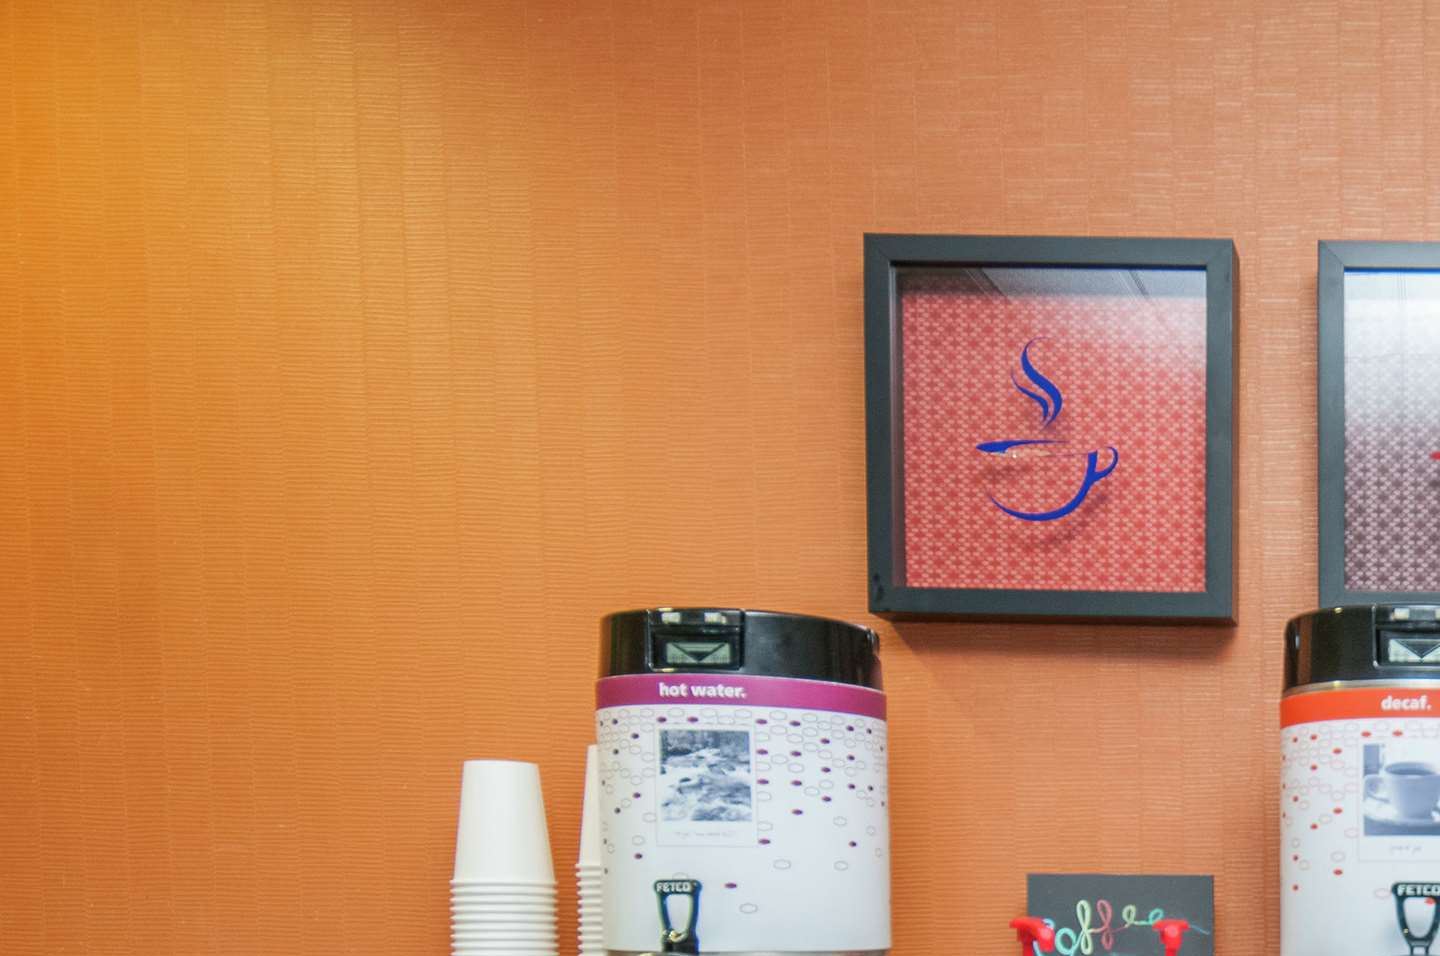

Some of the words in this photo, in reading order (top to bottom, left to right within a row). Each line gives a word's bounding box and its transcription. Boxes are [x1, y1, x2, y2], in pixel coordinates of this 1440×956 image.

[659, 682, 687, 698] hot
[690, 684, 747, 698] water.
[1381, 695, 1432, 711] decaf.
